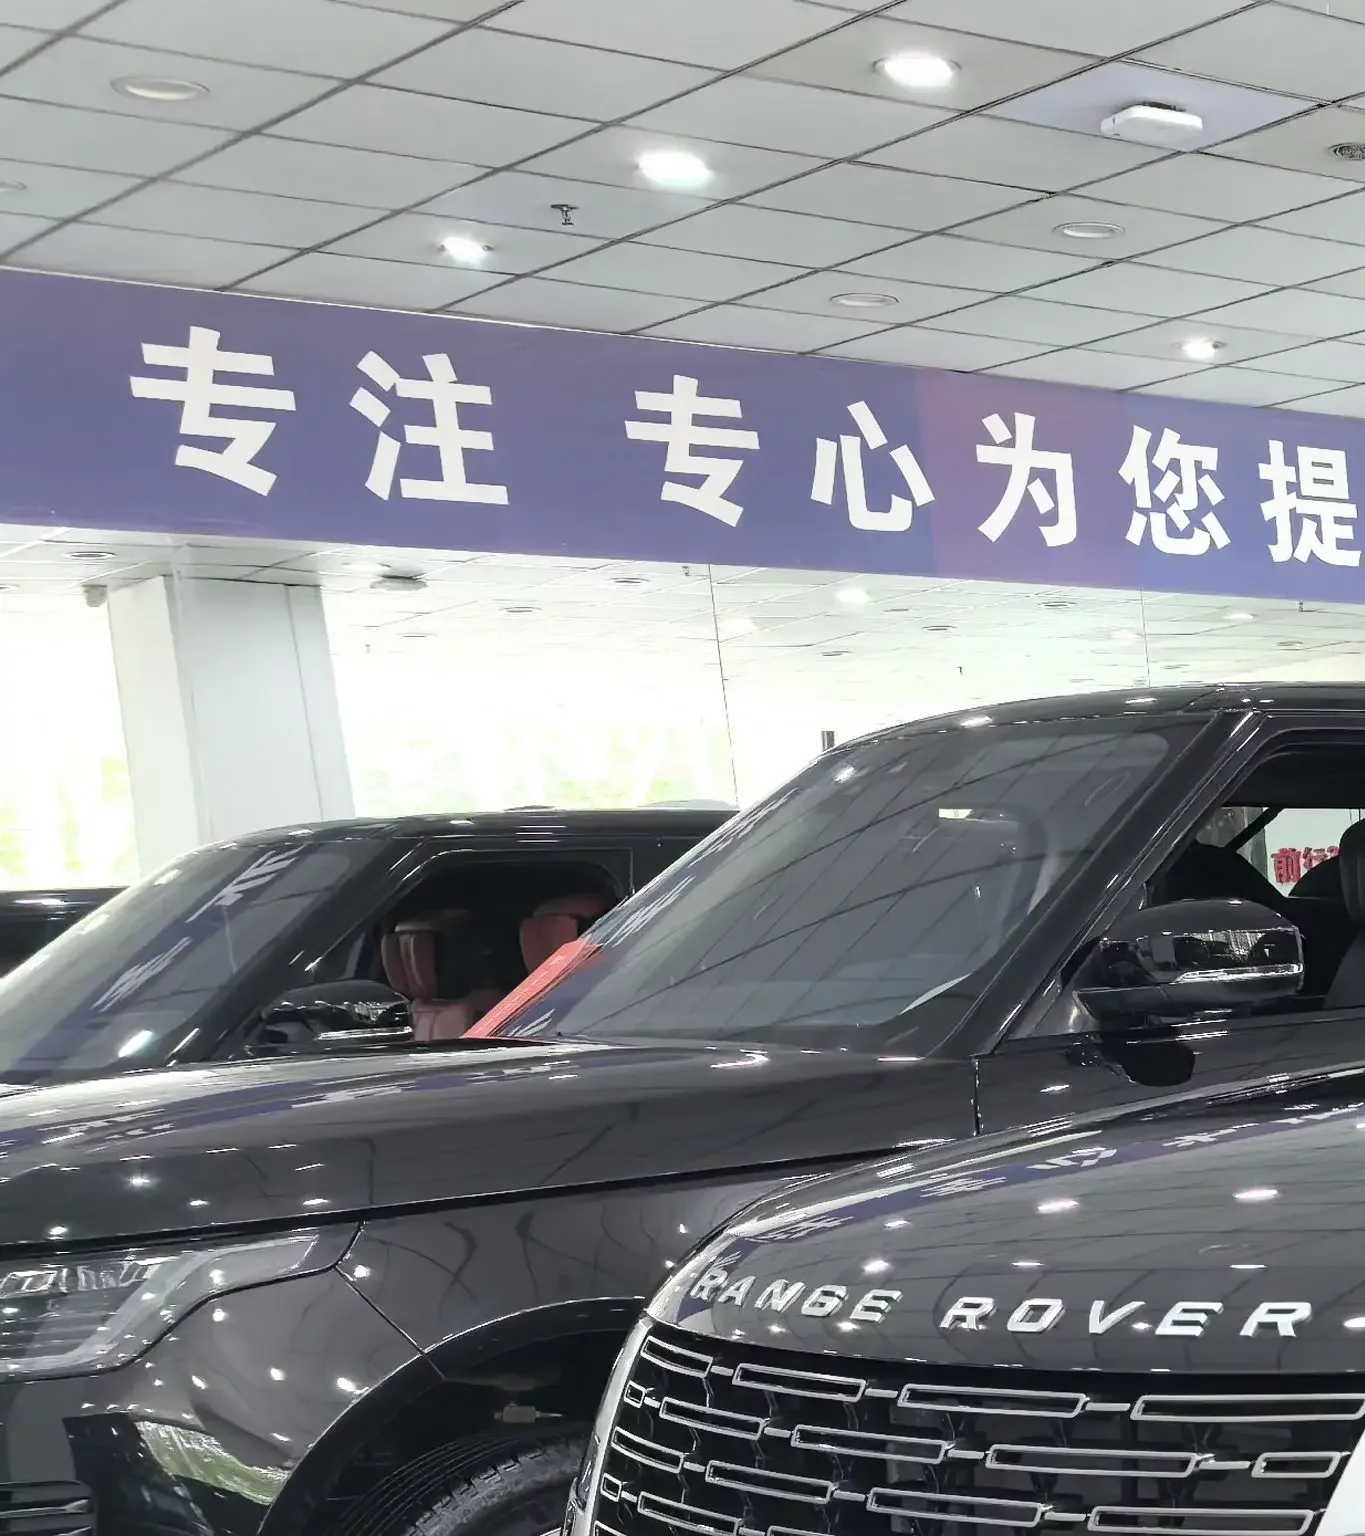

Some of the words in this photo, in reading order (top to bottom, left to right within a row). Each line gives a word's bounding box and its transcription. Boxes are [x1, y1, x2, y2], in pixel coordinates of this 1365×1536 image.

[129, 326, 510, 506] 专注
[690, 1267, 903, 1324] RANGE
[940, 1297, 1313, 1338] ROVER
